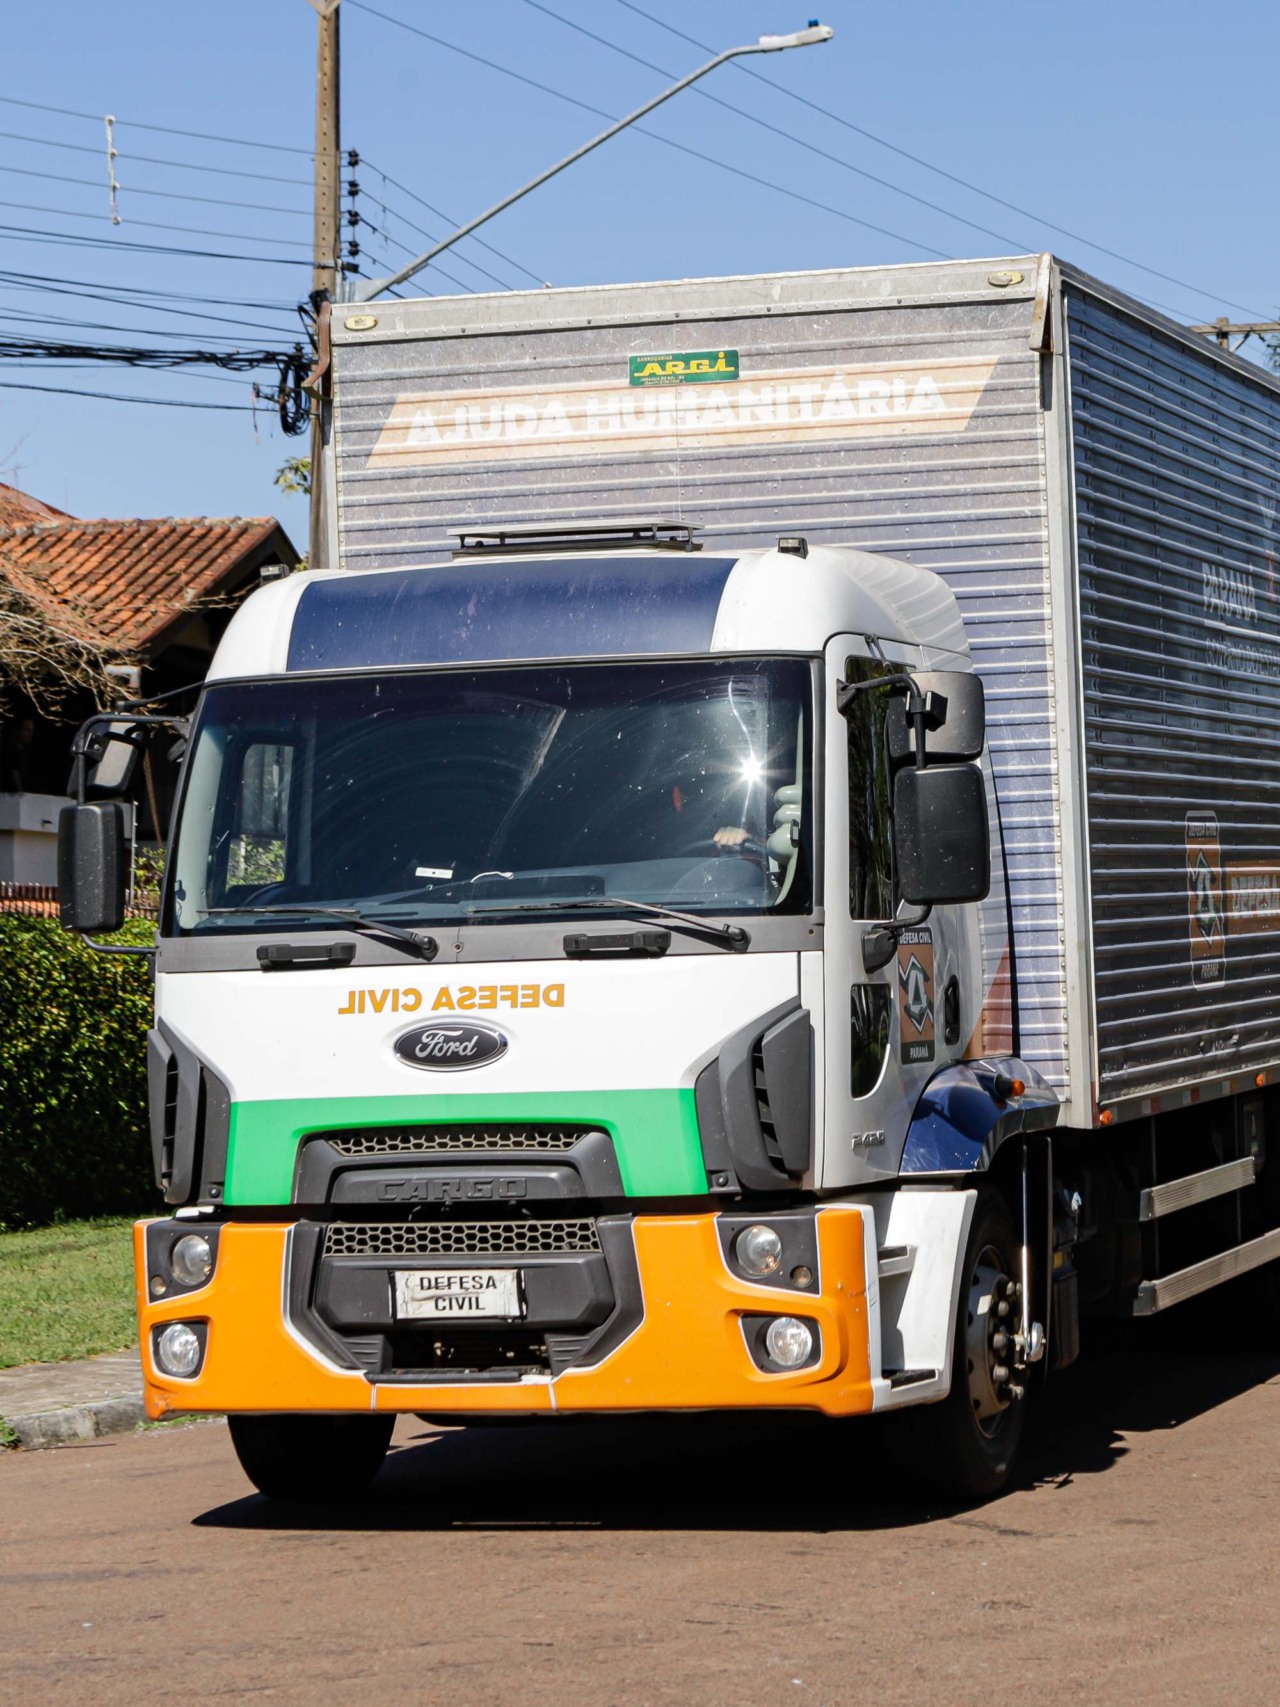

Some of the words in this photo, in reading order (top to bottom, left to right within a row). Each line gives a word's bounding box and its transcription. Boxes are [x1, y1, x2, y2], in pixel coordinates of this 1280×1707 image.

[405, 398, 576, 444] AJUDA
[586, 371, 949, 433] HUMANITÁRIA
[1231, 872, 1280, 919] DEFESA
[900, 931, 918, 944] DEFESA
[415, 1029, 480, 1058] Ford
[376, 1177, 528, 1201] CARGO
[419, 1275, 498, 1291] DEFESA
[434, 1296, 486, 1312] CIVIL
